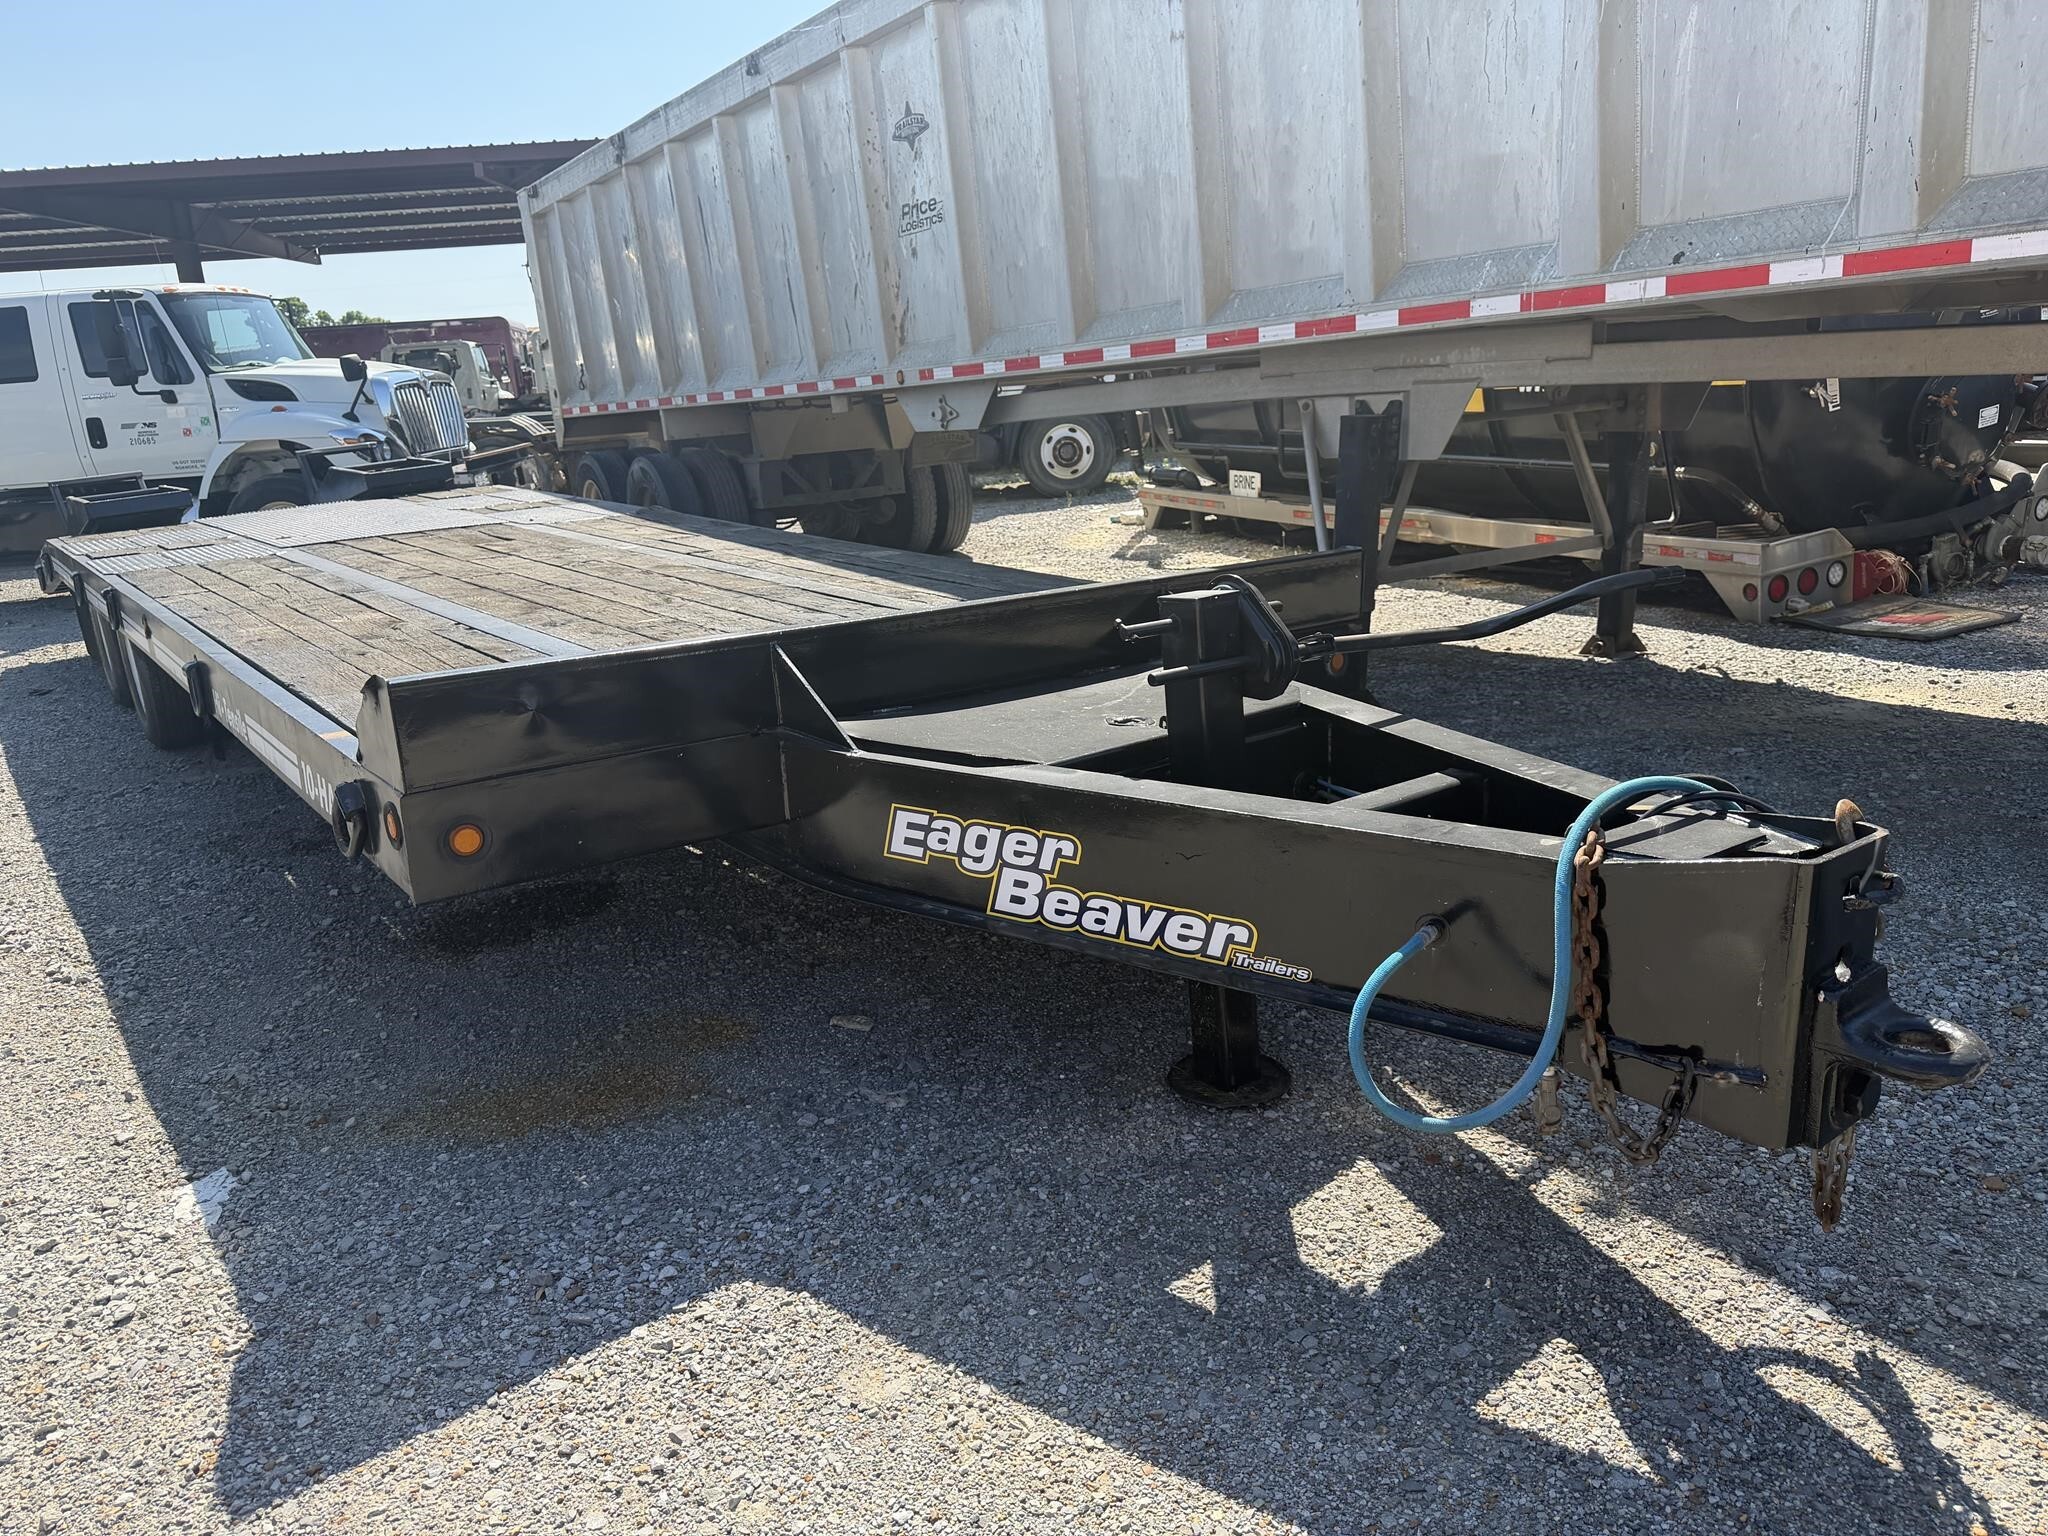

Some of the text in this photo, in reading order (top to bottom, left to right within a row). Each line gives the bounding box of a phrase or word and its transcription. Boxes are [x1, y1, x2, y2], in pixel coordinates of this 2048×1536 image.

[895, 116, 924, 133] TRAILSTAR
[902, 198, 937, 220] Price
[901, 213, 943, 233] LOGISTICS
[129, 437, 156, 446] 210685
[1233, 474, 1256, 490] BRINE
[887, 807, 1078, 875] Eager
[990, 865, 1254, 961] Beaver
[1234, 951, 1311, 982] Trailers
